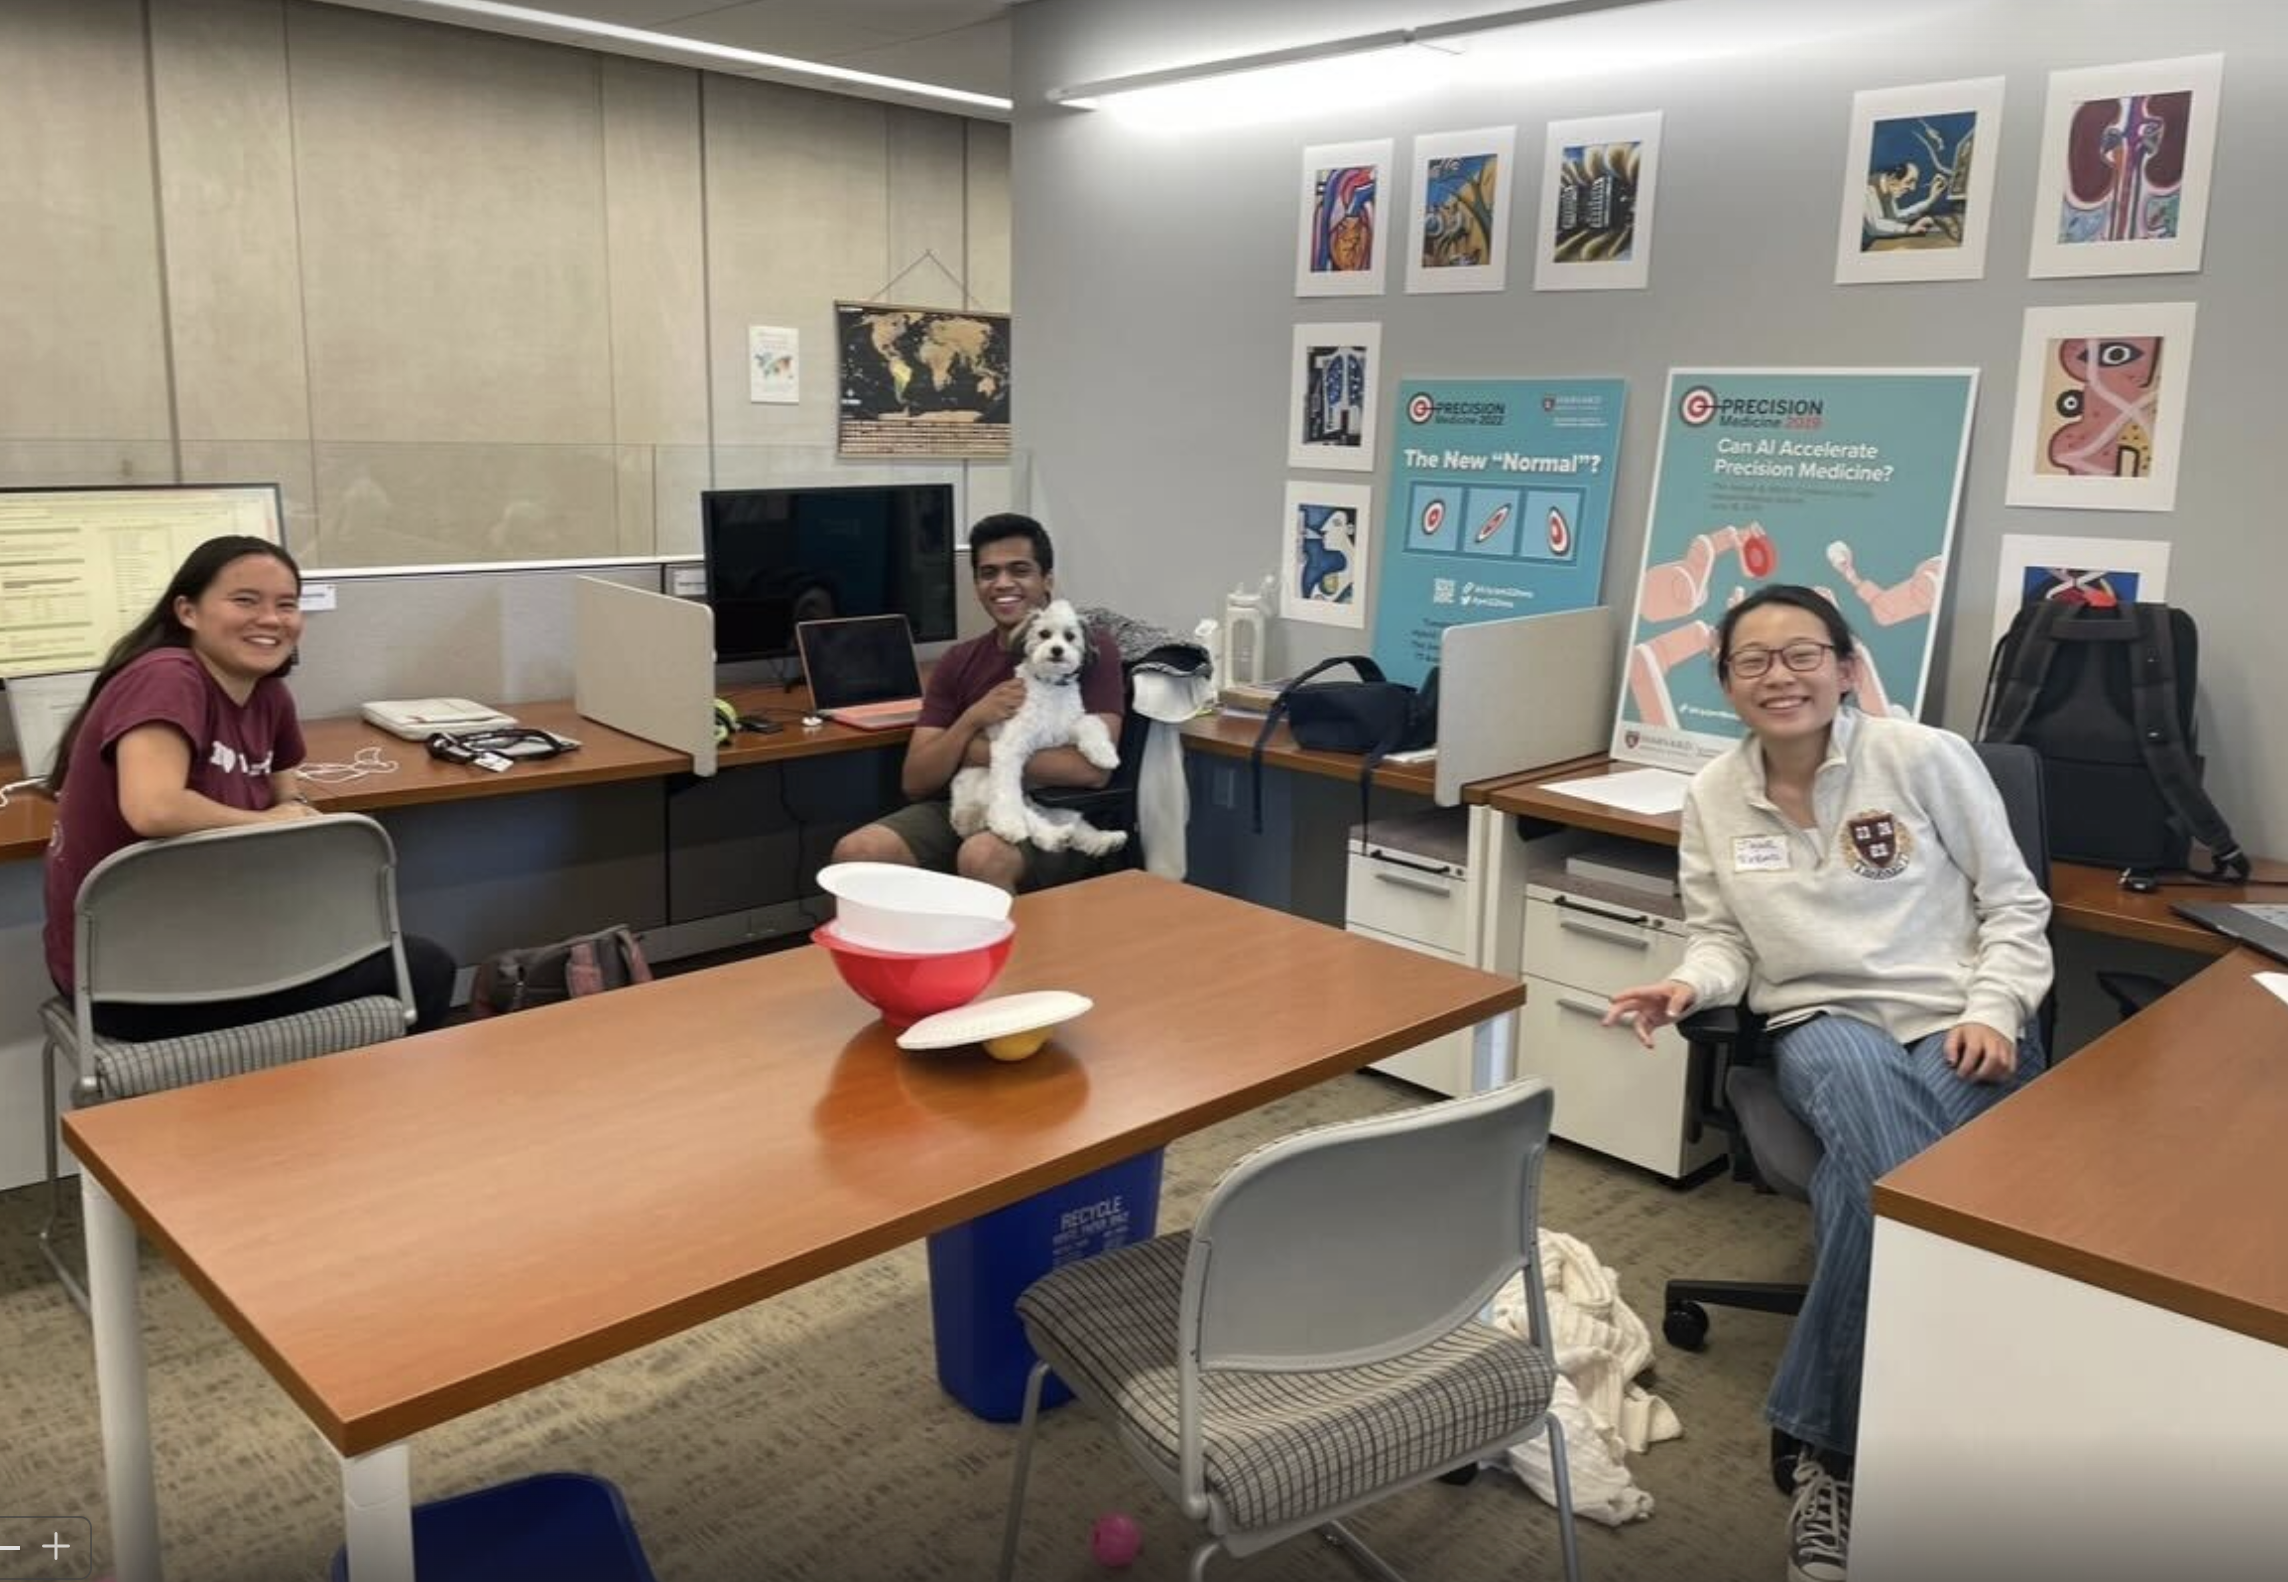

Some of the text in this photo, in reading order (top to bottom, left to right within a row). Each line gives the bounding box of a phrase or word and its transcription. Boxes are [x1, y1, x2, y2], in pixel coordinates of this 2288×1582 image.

[1437, 402, 1505, 415] PRECISION
[1721, 399, 1824, 415] PRECISION
[1435, 415, 1477, 425] Medicine
[1719, 415, 1782, 428] Medicine
[1717, 438, 1879, 459] Can AI Accelerate
[1404, 449, 1438, 468] The
[1443, 451, 1487, 470] New
[1714, 459, 1895, 482] Precision Medicine?
[1060, 1195, 1122, 1231] RECYCLE
